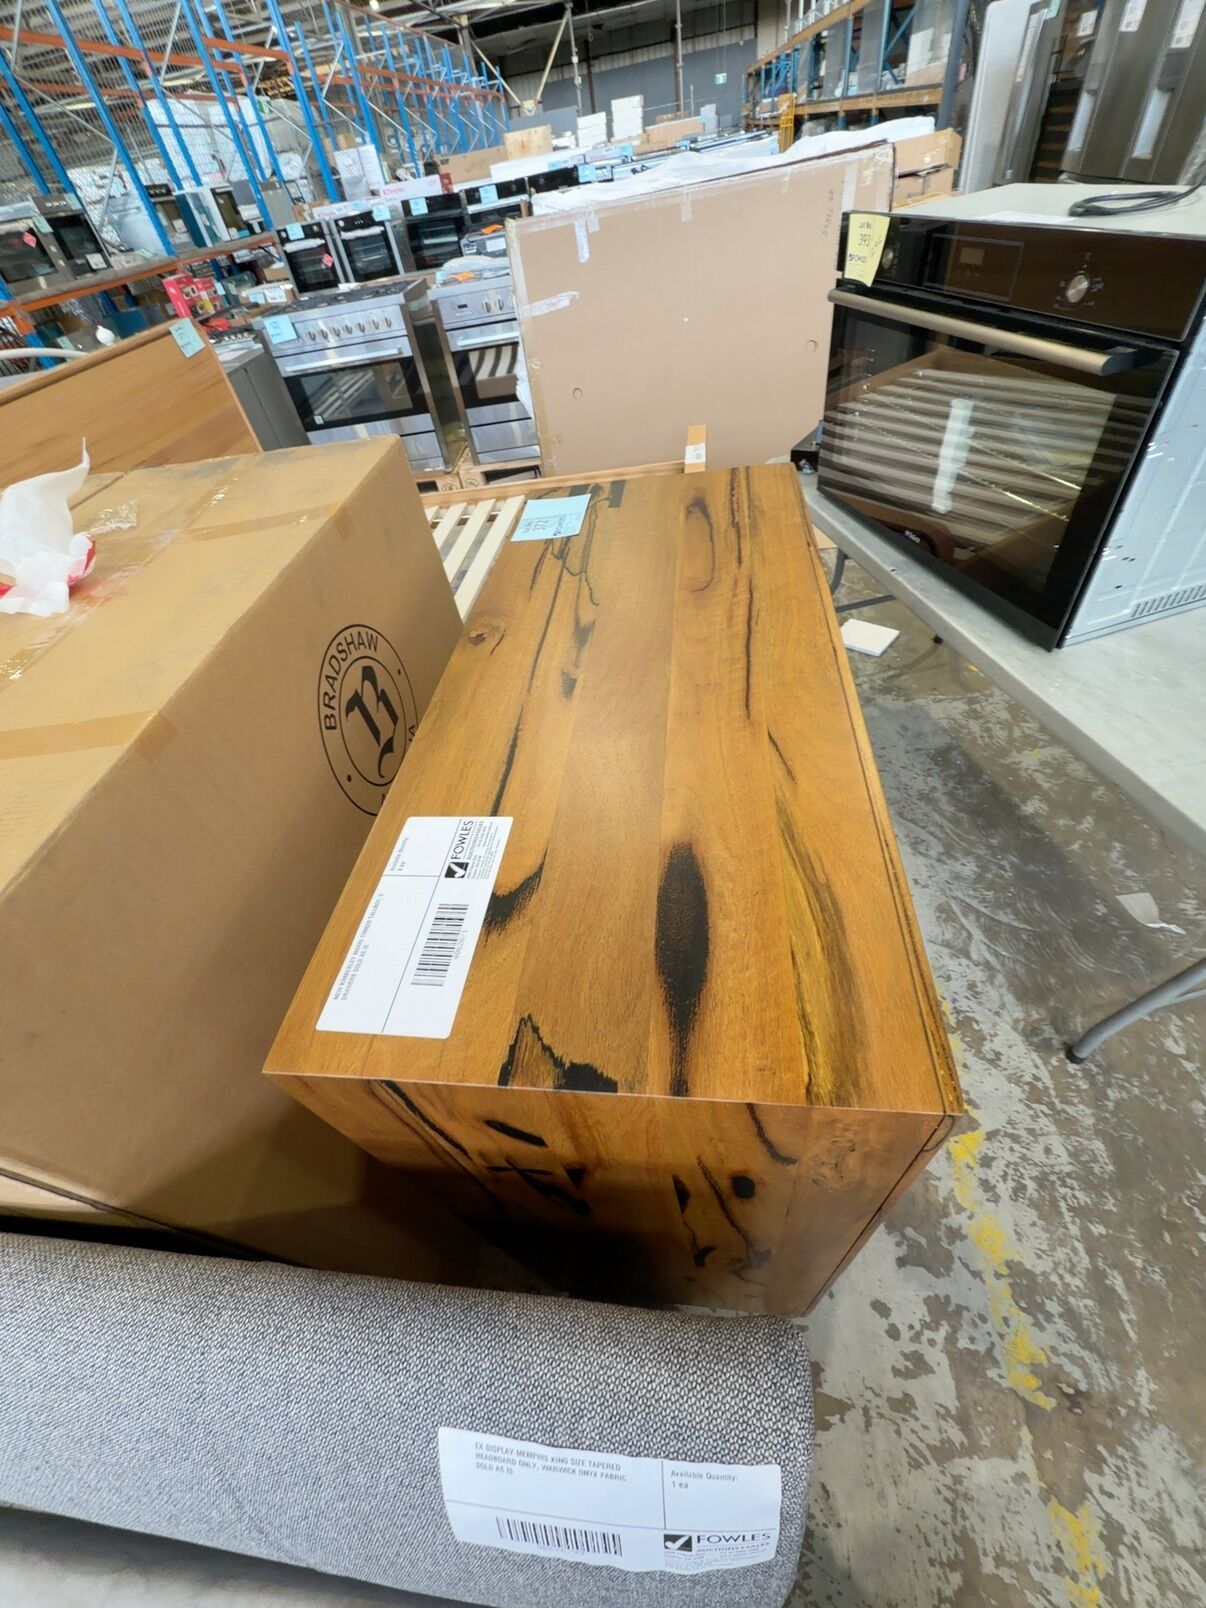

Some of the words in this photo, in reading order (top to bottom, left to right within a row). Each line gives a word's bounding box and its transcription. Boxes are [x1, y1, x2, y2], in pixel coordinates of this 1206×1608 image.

[858, 233, 871, 247] 393
[322, 630, 379, 731] BRADSHAW
[451, 820, 474, 860] FOWLES
[352, 958, 363, 972] SOLD
[475, 1442, 483, 1451] EX
[485, 1444, 514, 1456] DISPLAY
[516, 1449, 549, 1462] MEMPHIS
[550, 1454, 569, 1465] KING
[570, 1456, 586, 1468] SIZE
[588, 1459, 621, 1471] TAPERED
[475, 1452, 517, 1466] HEADBOARD
[541, 1463, 577, 1476] WARWICK
[579, 1468, 598, 1479] ONYX
[600, 1471, 627, 1482] FABRIC
[476, 1461, 493, 1472] SOLD
[495, 1464, 505, 1473] AS
[506, 1466, 514, 1475] IS
[670, 1470, 704, 1480] Available
[705, 1471, 738, 1483] Quantity:
[672, 1481, 676, 1489] 1
[696, 1532, 772, 1544] FOWLES
